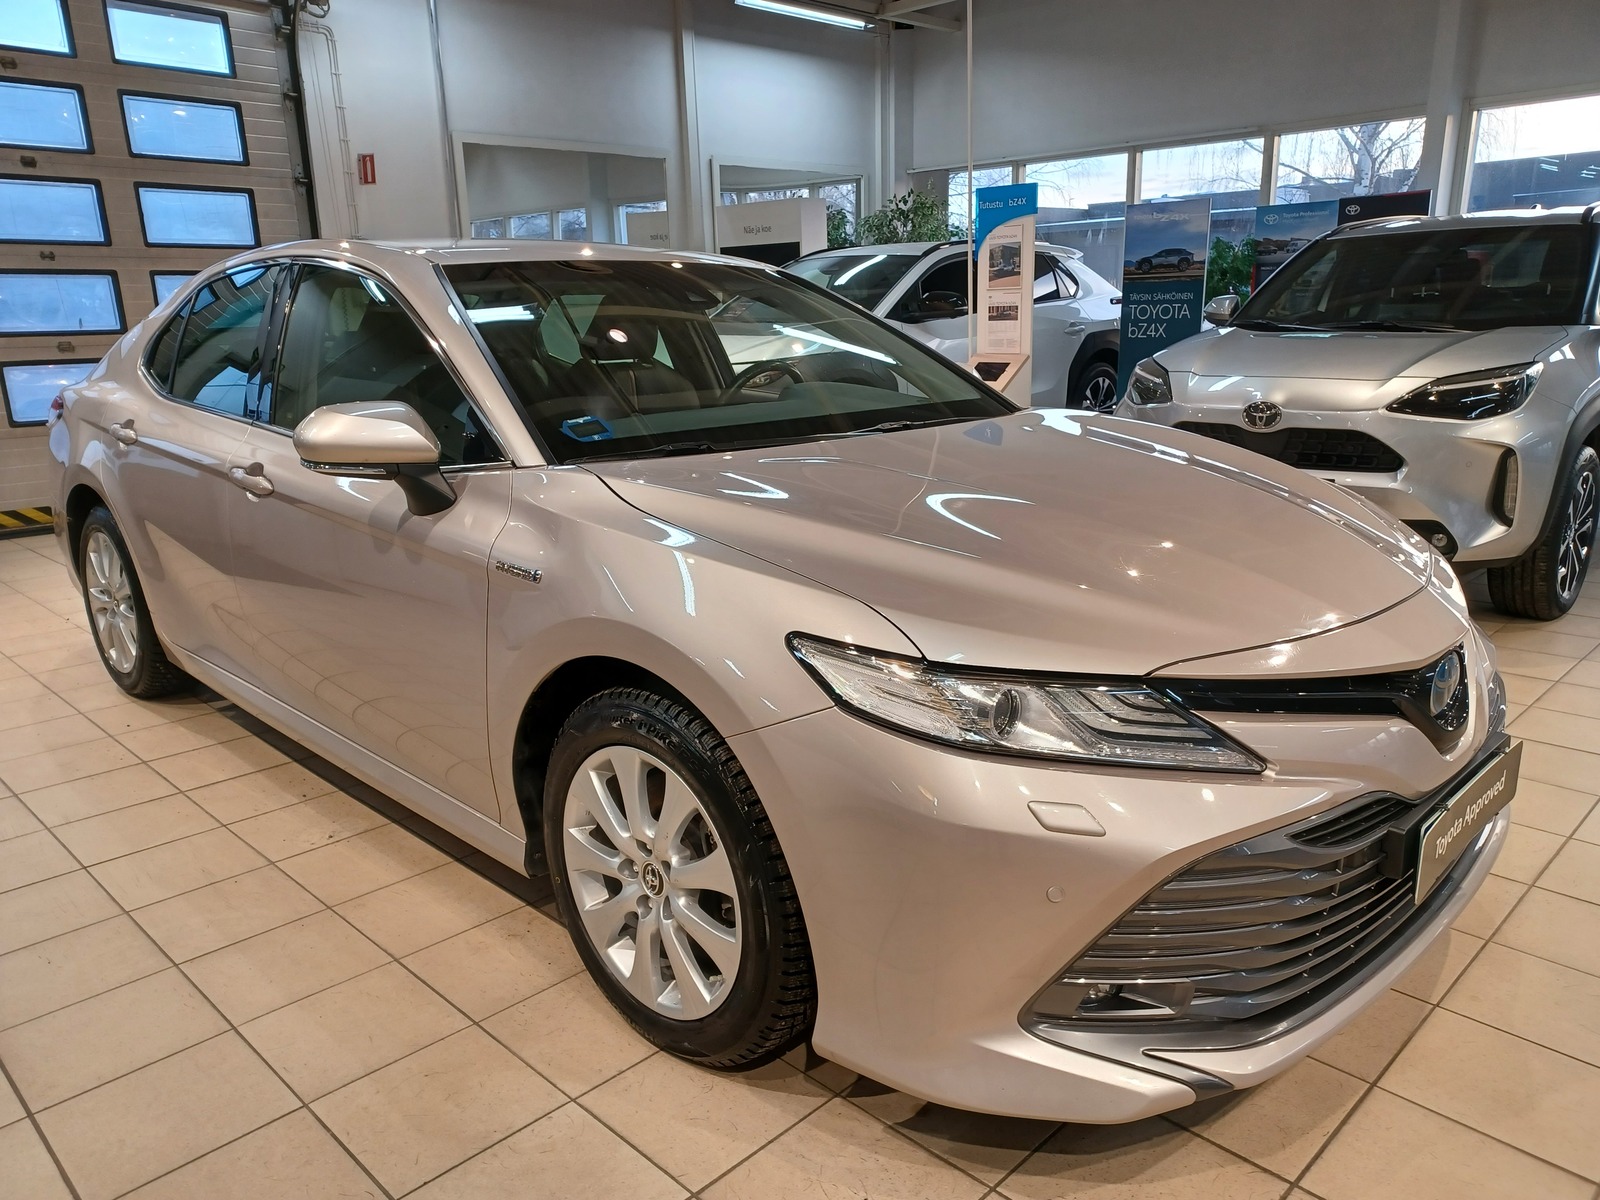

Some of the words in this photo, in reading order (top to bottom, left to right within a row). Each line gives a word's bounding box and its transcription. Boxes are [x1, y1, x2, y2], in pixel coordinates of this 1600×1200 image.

[979, 200, 1003, 209] Tutustu
[1009, 197, 1026, 206] bZ4X
[1153, 292, 1194, 300] SÄHKÖINEN
[1129, 303, 1190, 320] TOYOTA
[1128, 323, 1167, 338] bZ4X
[1436, 816, 1463, 859] Toyota
[1463, 770, 1507, 827] Approved
